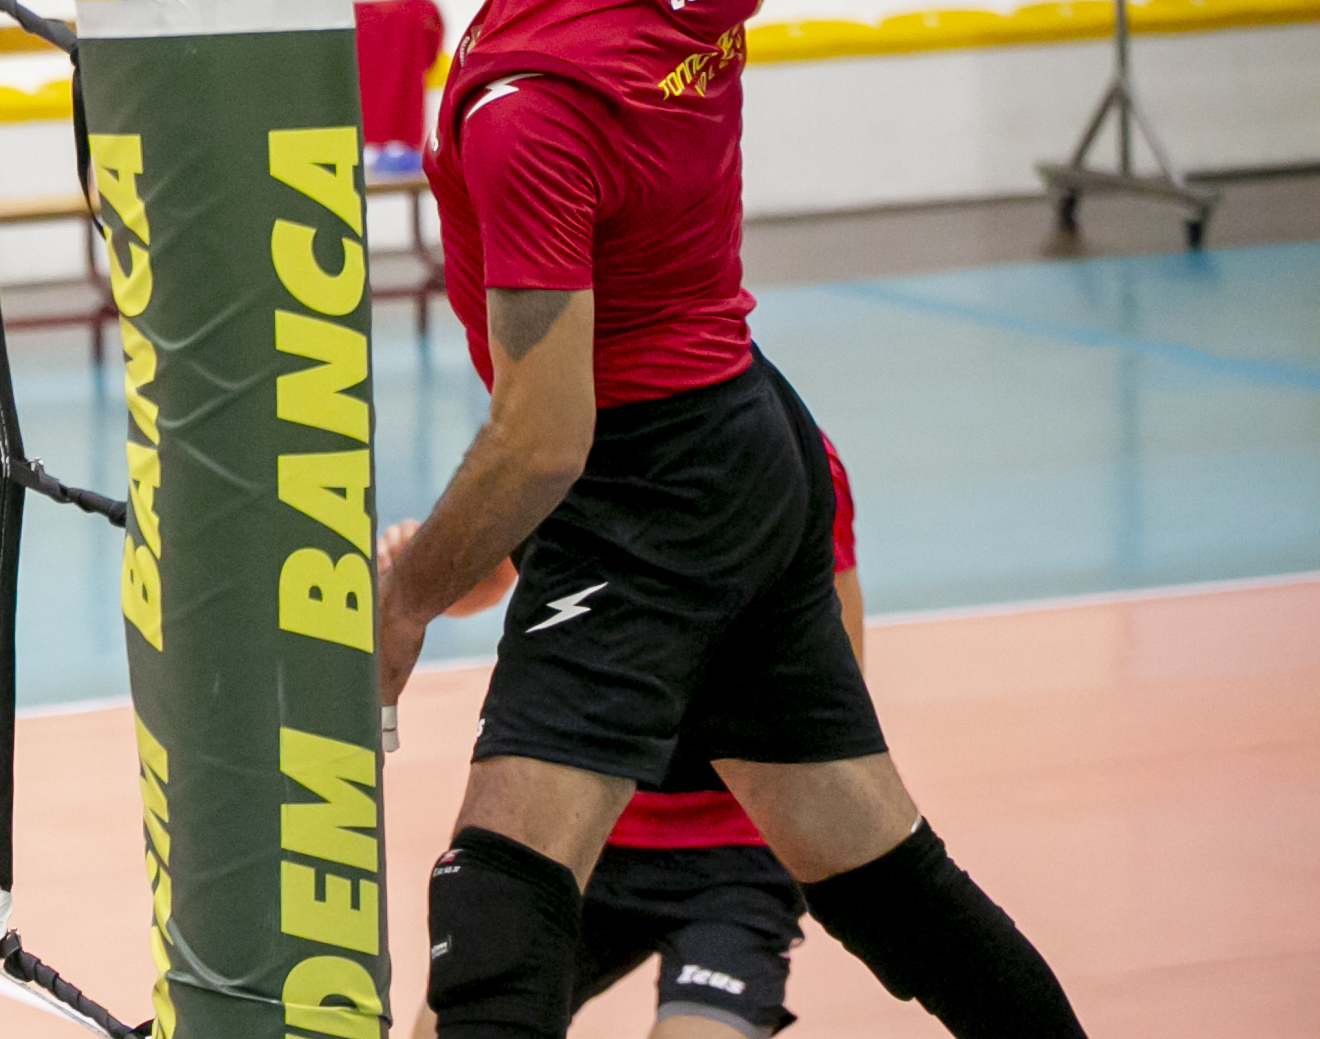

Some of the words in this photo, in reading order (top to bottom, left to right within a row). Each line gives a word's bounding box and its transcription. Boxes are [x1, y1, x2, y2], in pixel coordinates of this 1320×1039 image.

[88, 133, 163, 652] BANCA
[268, 126, 374, 654] BANCA
[280, 727, 383, 1039] DEM
[676, 964, 746, 995] Zeus
